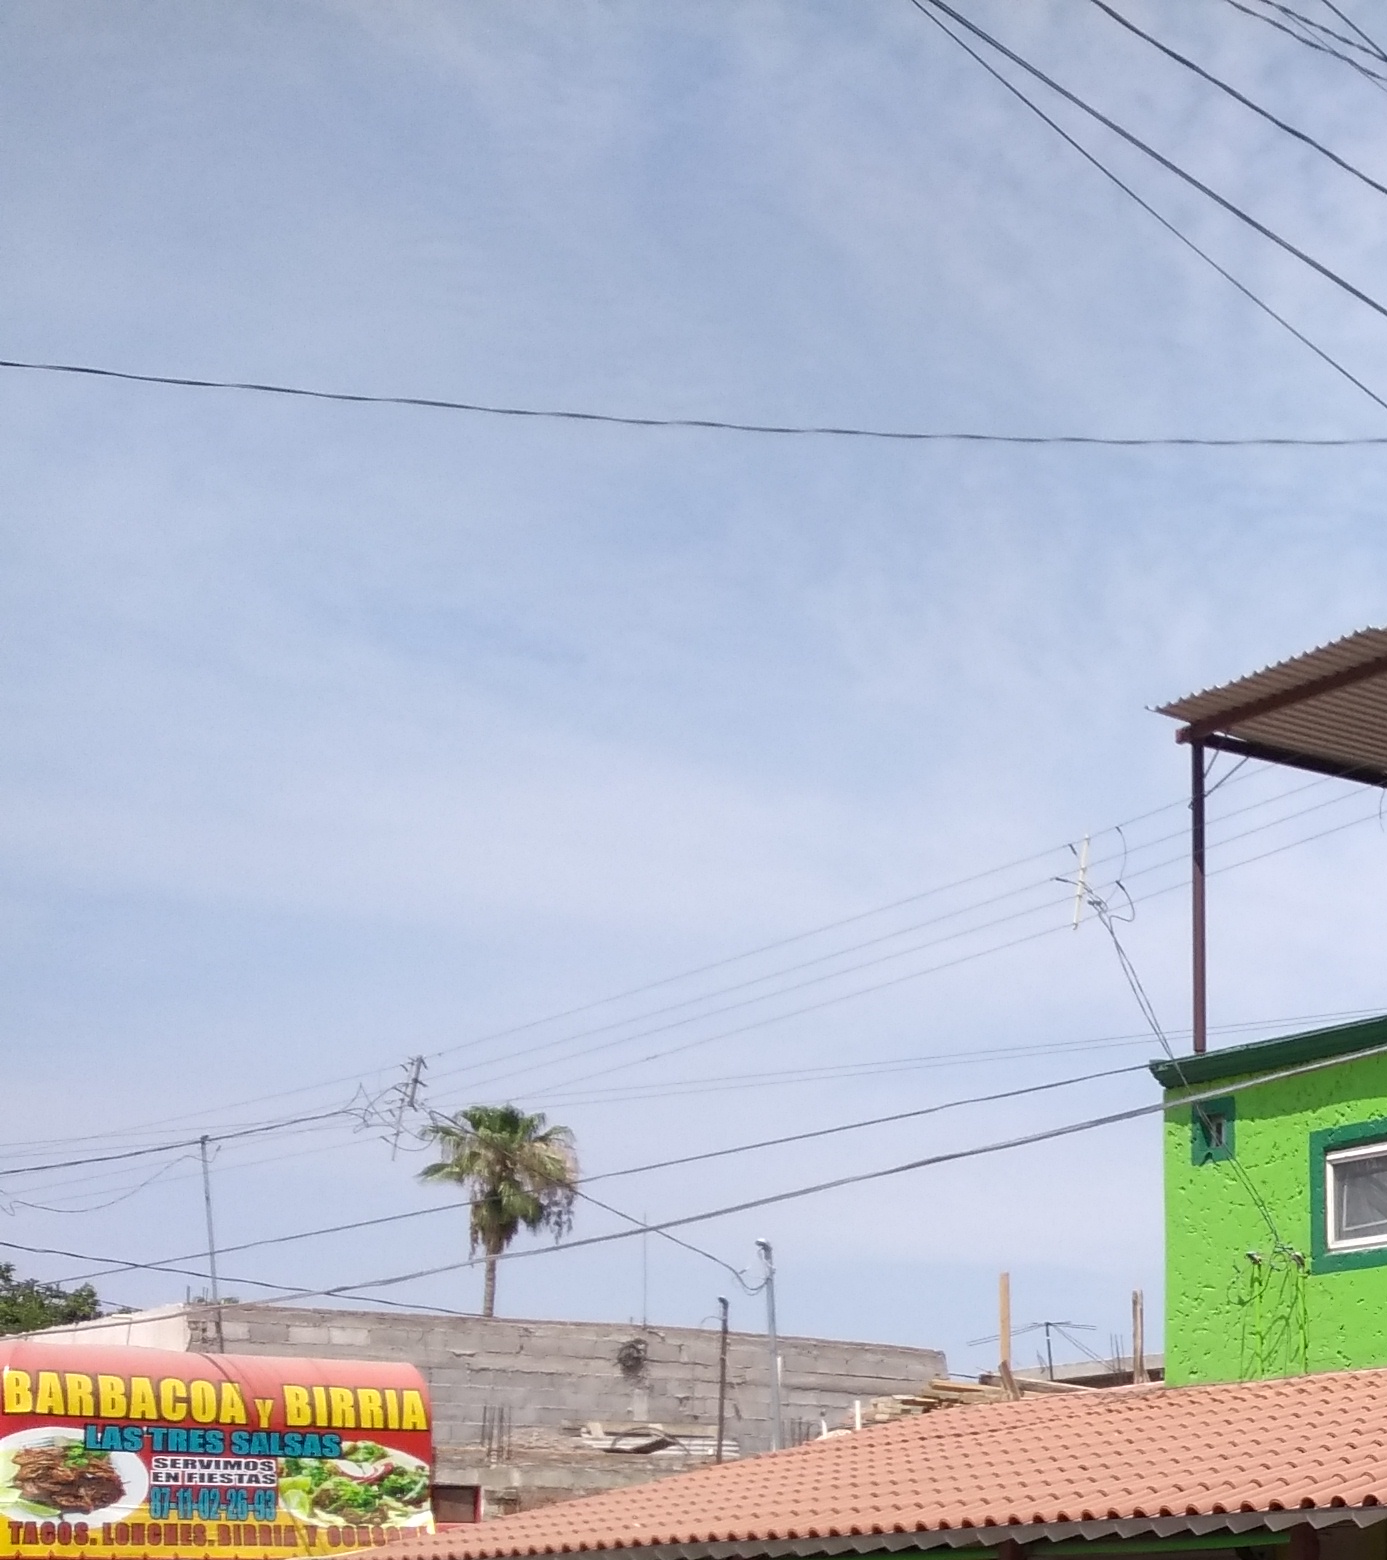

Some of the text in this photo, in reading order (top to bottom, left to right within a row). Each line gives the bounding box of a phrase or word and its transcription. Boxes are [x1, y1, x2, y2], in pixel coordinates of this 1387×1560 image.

[3, 1369, 248, 1425] BARBACOA
[282, 1385, 428, 1430] BIRRIA
[85, 1424, 342, 1458] LAS TRES SALSAS
[153, 1457, 274, 1472] SERVIMOS
[152, 1471, 277, 1485] EN FIESTAS
[217, 1524, 298, 1546] BIRRIA
[304, 1525, 318, 1546] Y
